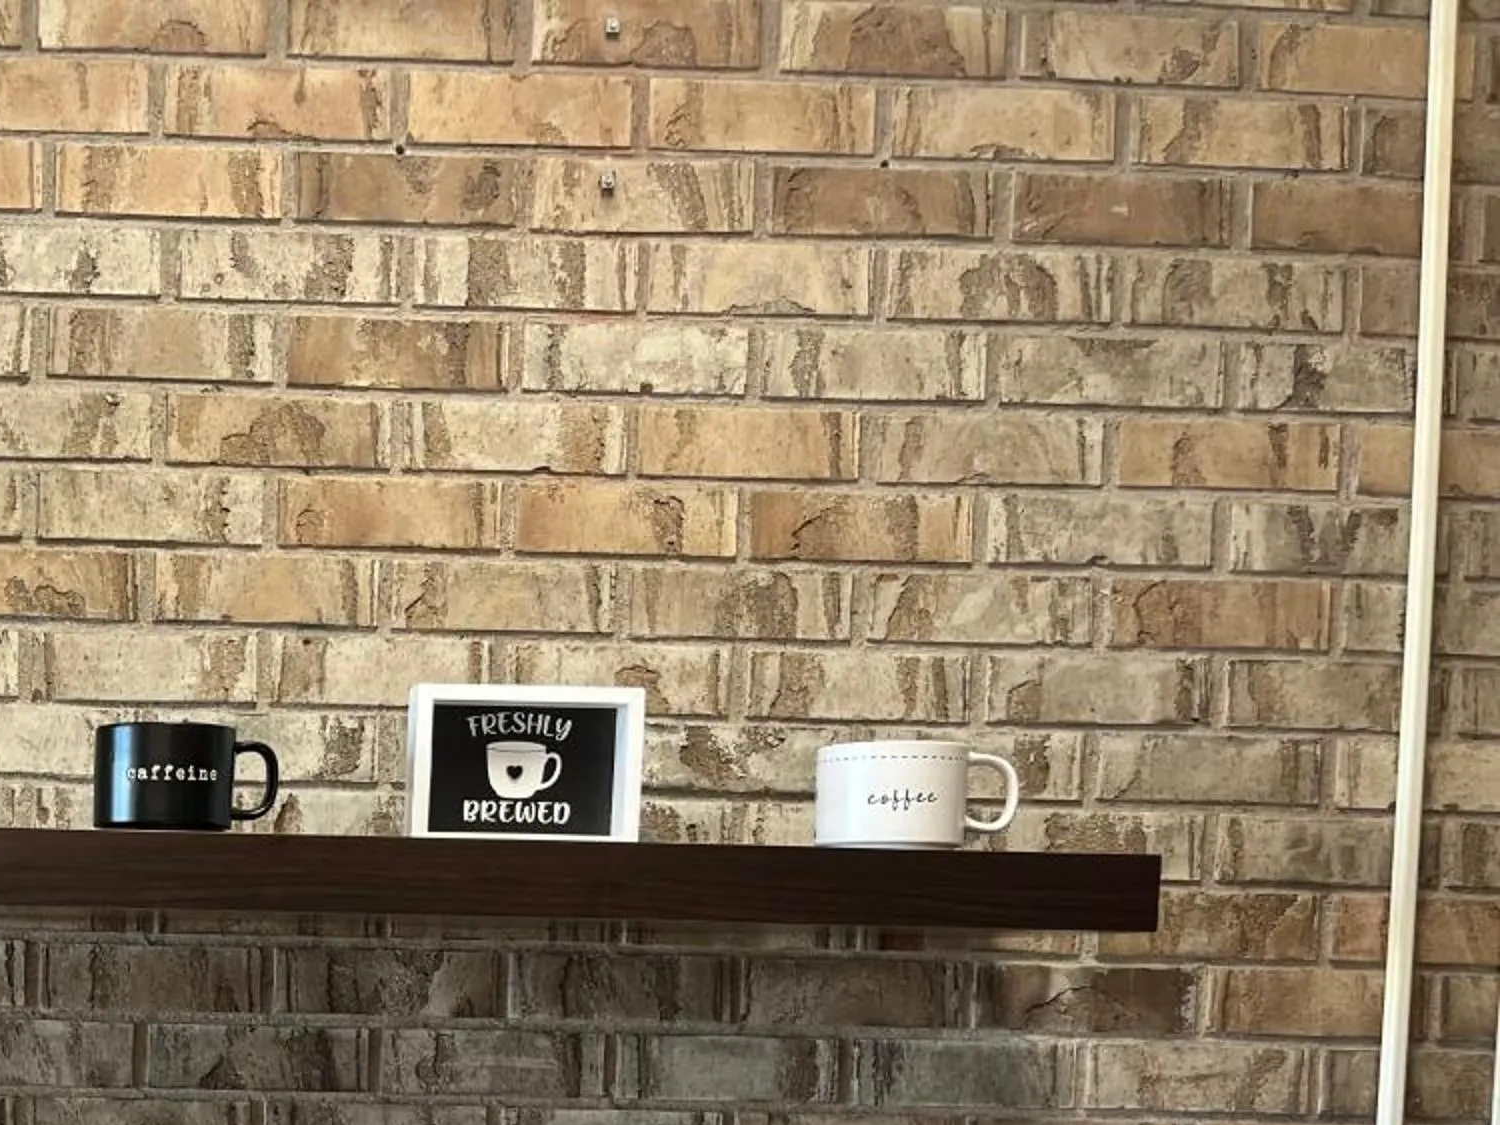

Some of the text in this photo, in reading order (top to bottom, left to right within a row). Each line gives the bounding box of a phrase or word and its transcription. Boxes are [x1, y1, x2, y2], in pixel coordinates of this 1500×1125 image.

[466, 710, 573, 741] FRESHLY
[126, 764, 218, 782] caffeine
[867, 787, 939, 811] coffee
[462, 799, 571, 825] BREWED
